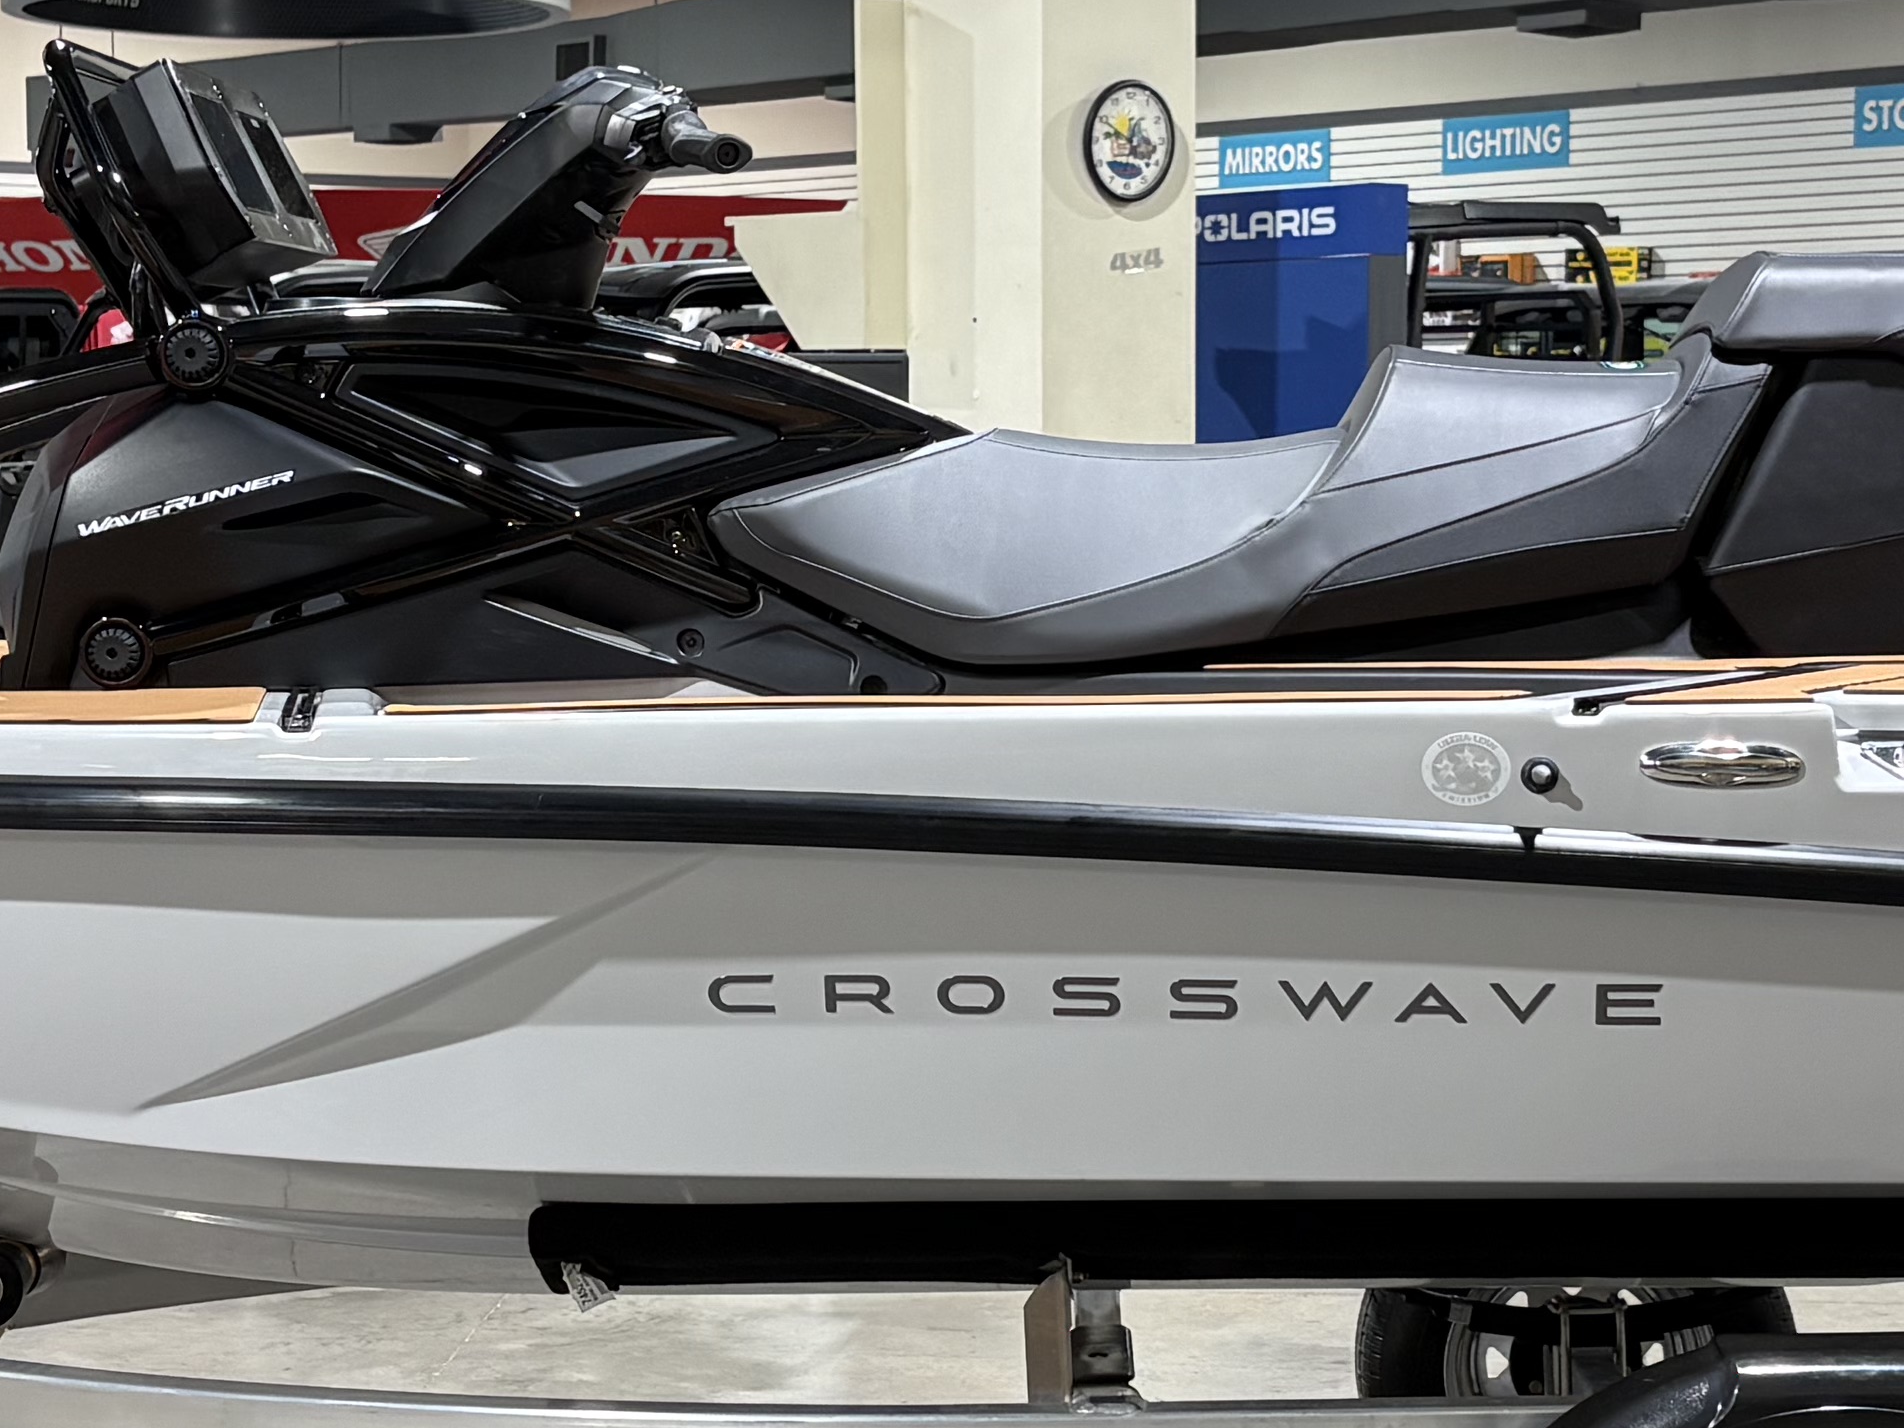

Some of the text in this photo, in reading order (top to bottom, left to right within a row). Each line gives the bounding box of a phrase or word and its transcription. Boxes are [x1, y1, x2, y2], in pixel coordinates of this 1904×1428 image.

[1223, 140, 1323, 175] MIRRORS
[1445, 123, 1562, 161] LIGHTING
[1109, 247, 1164, 272] 4x4
[707, 973, 1665, 1027] CROSSWAVE
